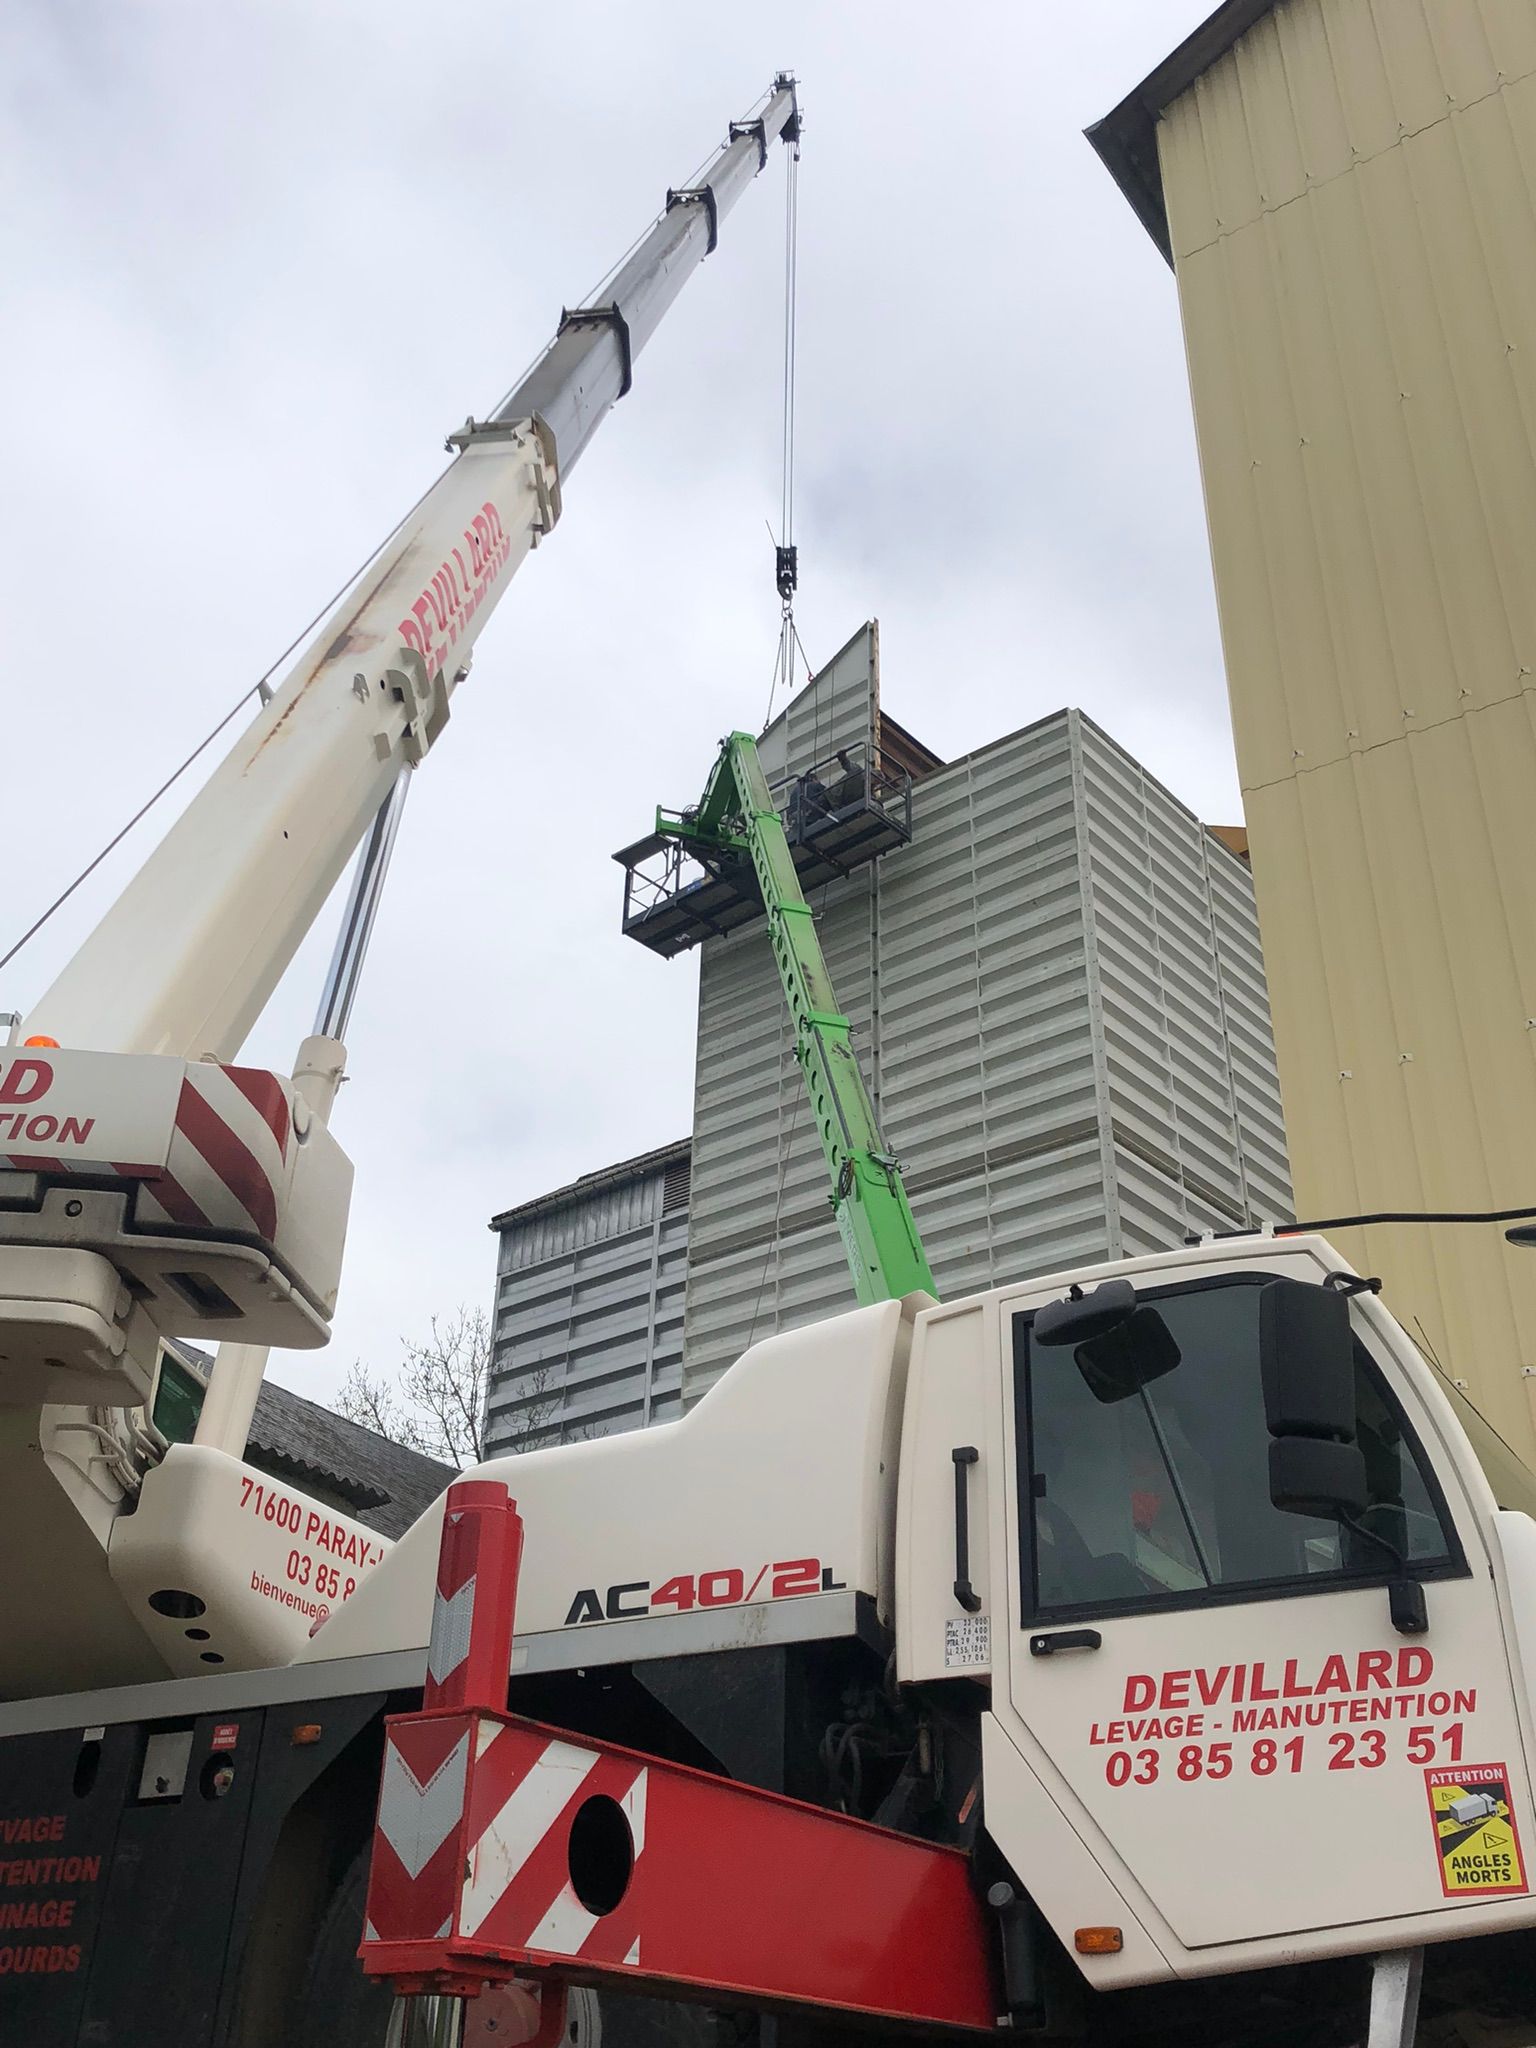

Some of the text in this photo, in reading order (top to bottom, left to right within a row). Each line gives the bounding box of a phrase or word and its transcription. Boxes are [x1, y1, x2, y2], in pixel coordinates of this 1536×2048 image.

[0, 1059, 54, 1104] D
[240, 1476, 302, 1534] 71600
[286, 1550, 312, 1585] 03
[315, 1563, 340, 1599] 85
[1123, 1647, 1434, 1713] DEVILLARD
[1089, 1713, 1204, 1746] LEVAGE
[1232, 1689, 1476, 1733] MANUTENTION
[1105, 1723, 1465, 1788] 03 85 81 23 51
[1430, 1768, 1504, 1785] ATTENTION
[1451, 1853, 1512, 1870] ANGLES
[1456, 1868, 1512, 1884] MORTS
